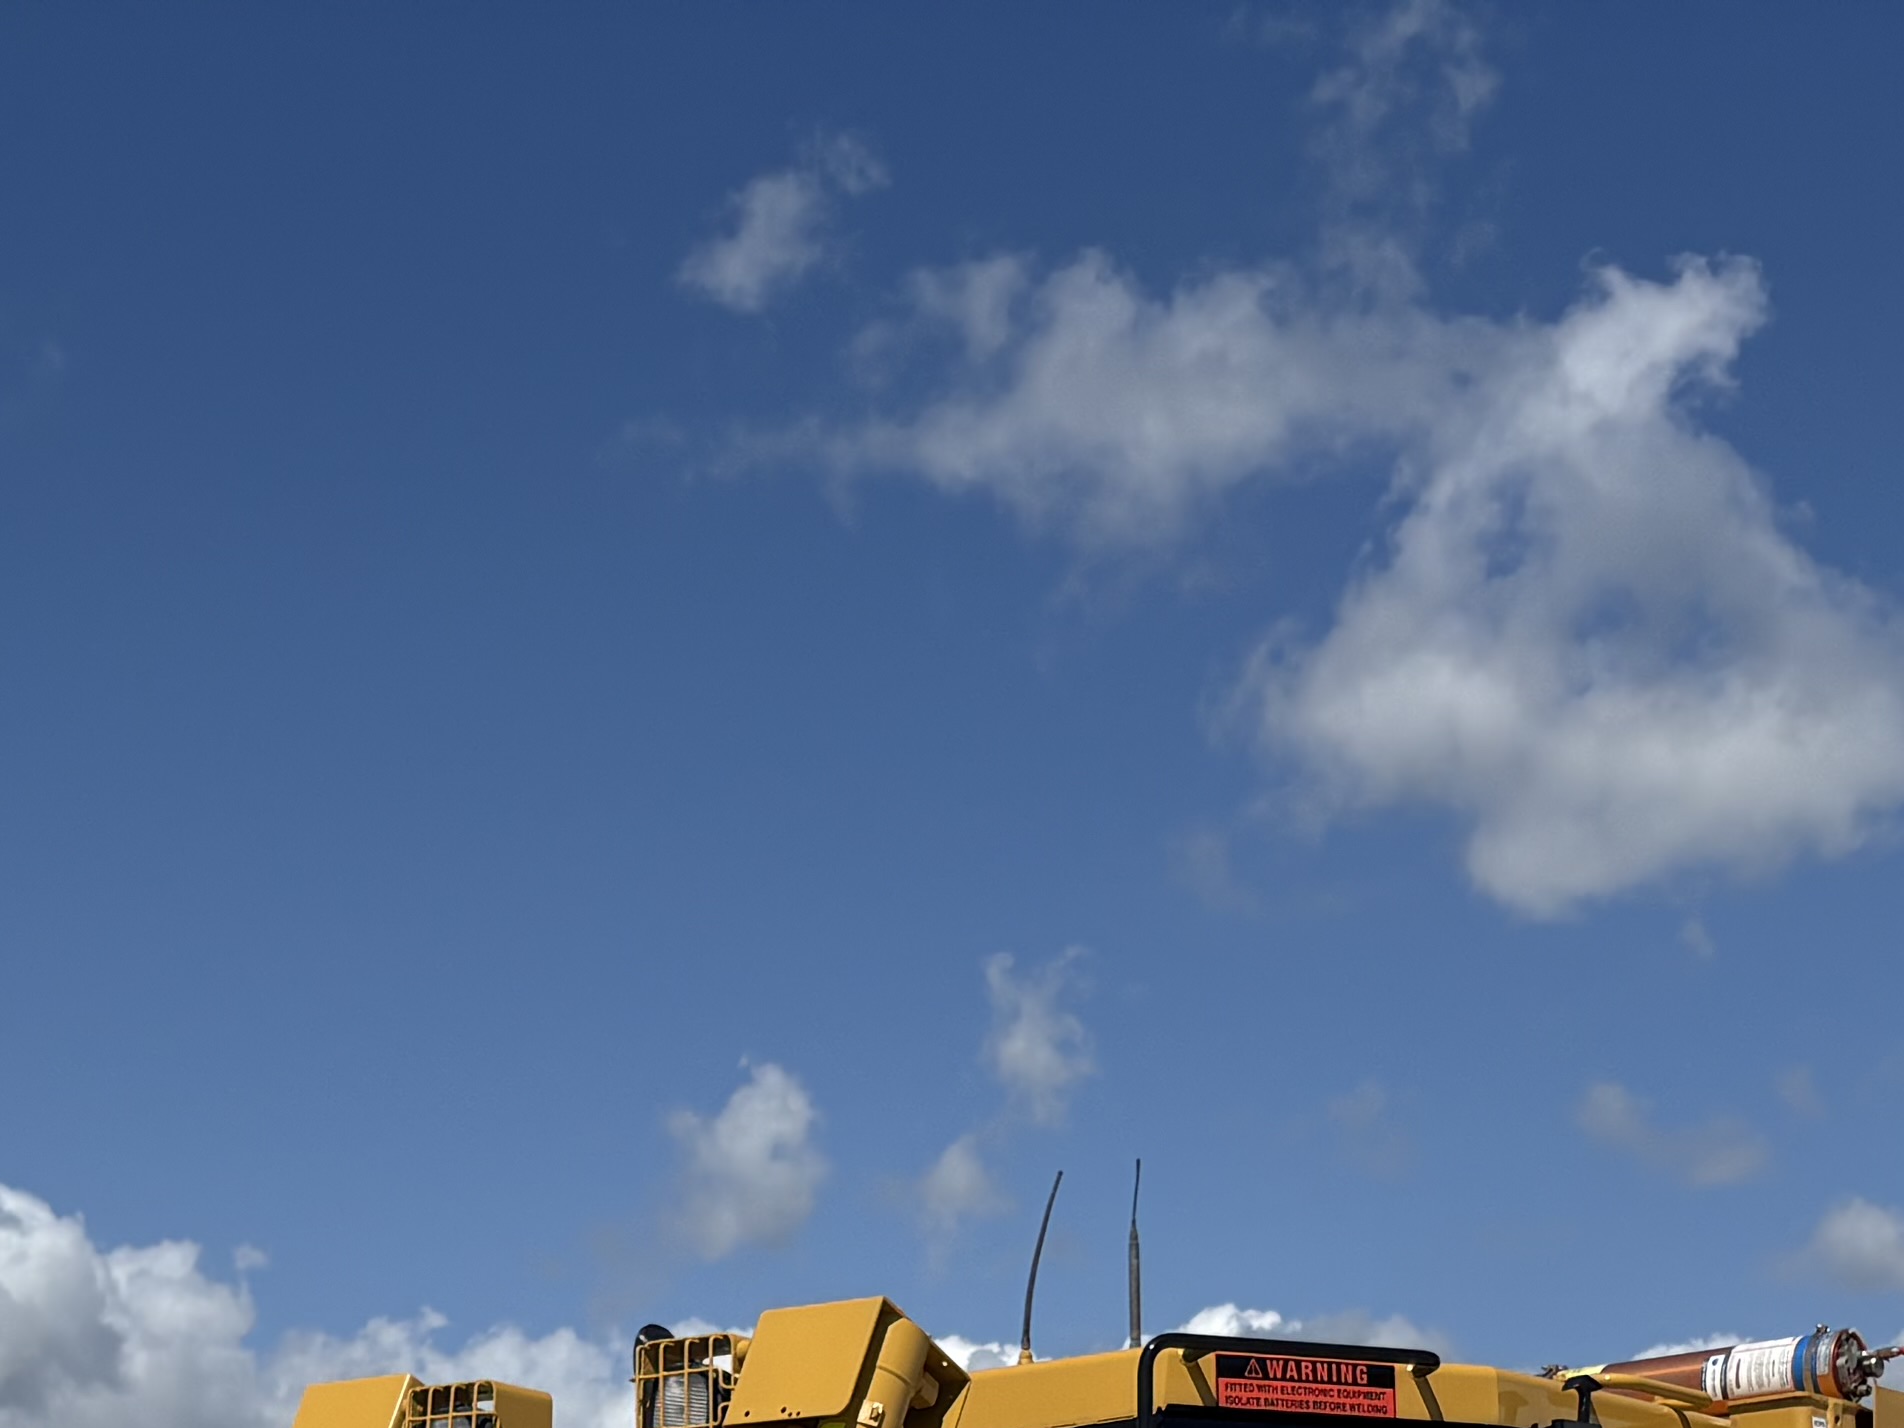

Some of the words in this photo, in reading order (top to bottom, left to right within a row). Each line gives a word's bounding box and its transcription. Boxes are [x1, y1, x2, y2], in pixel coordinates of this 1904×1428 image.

[1266, 1359, 1368, 1384] WARNING
[1224, 1382, 1254, 1393] FITTED
[1257, 1384, 1278, 1394] WITH
[1280, 1386, 1335, 1398] ELECTRONIC
[1337, 1389, 1387, 1401] EQUIPMENT
[1224, 1395, 1262, 1407] ISOLATE
[1264, 1398, 1310, 1410] BATTERIES
[1313, 1401, 1347, 1412] BEFORE
[1349, 1403, 1388, 1415] WELDING
